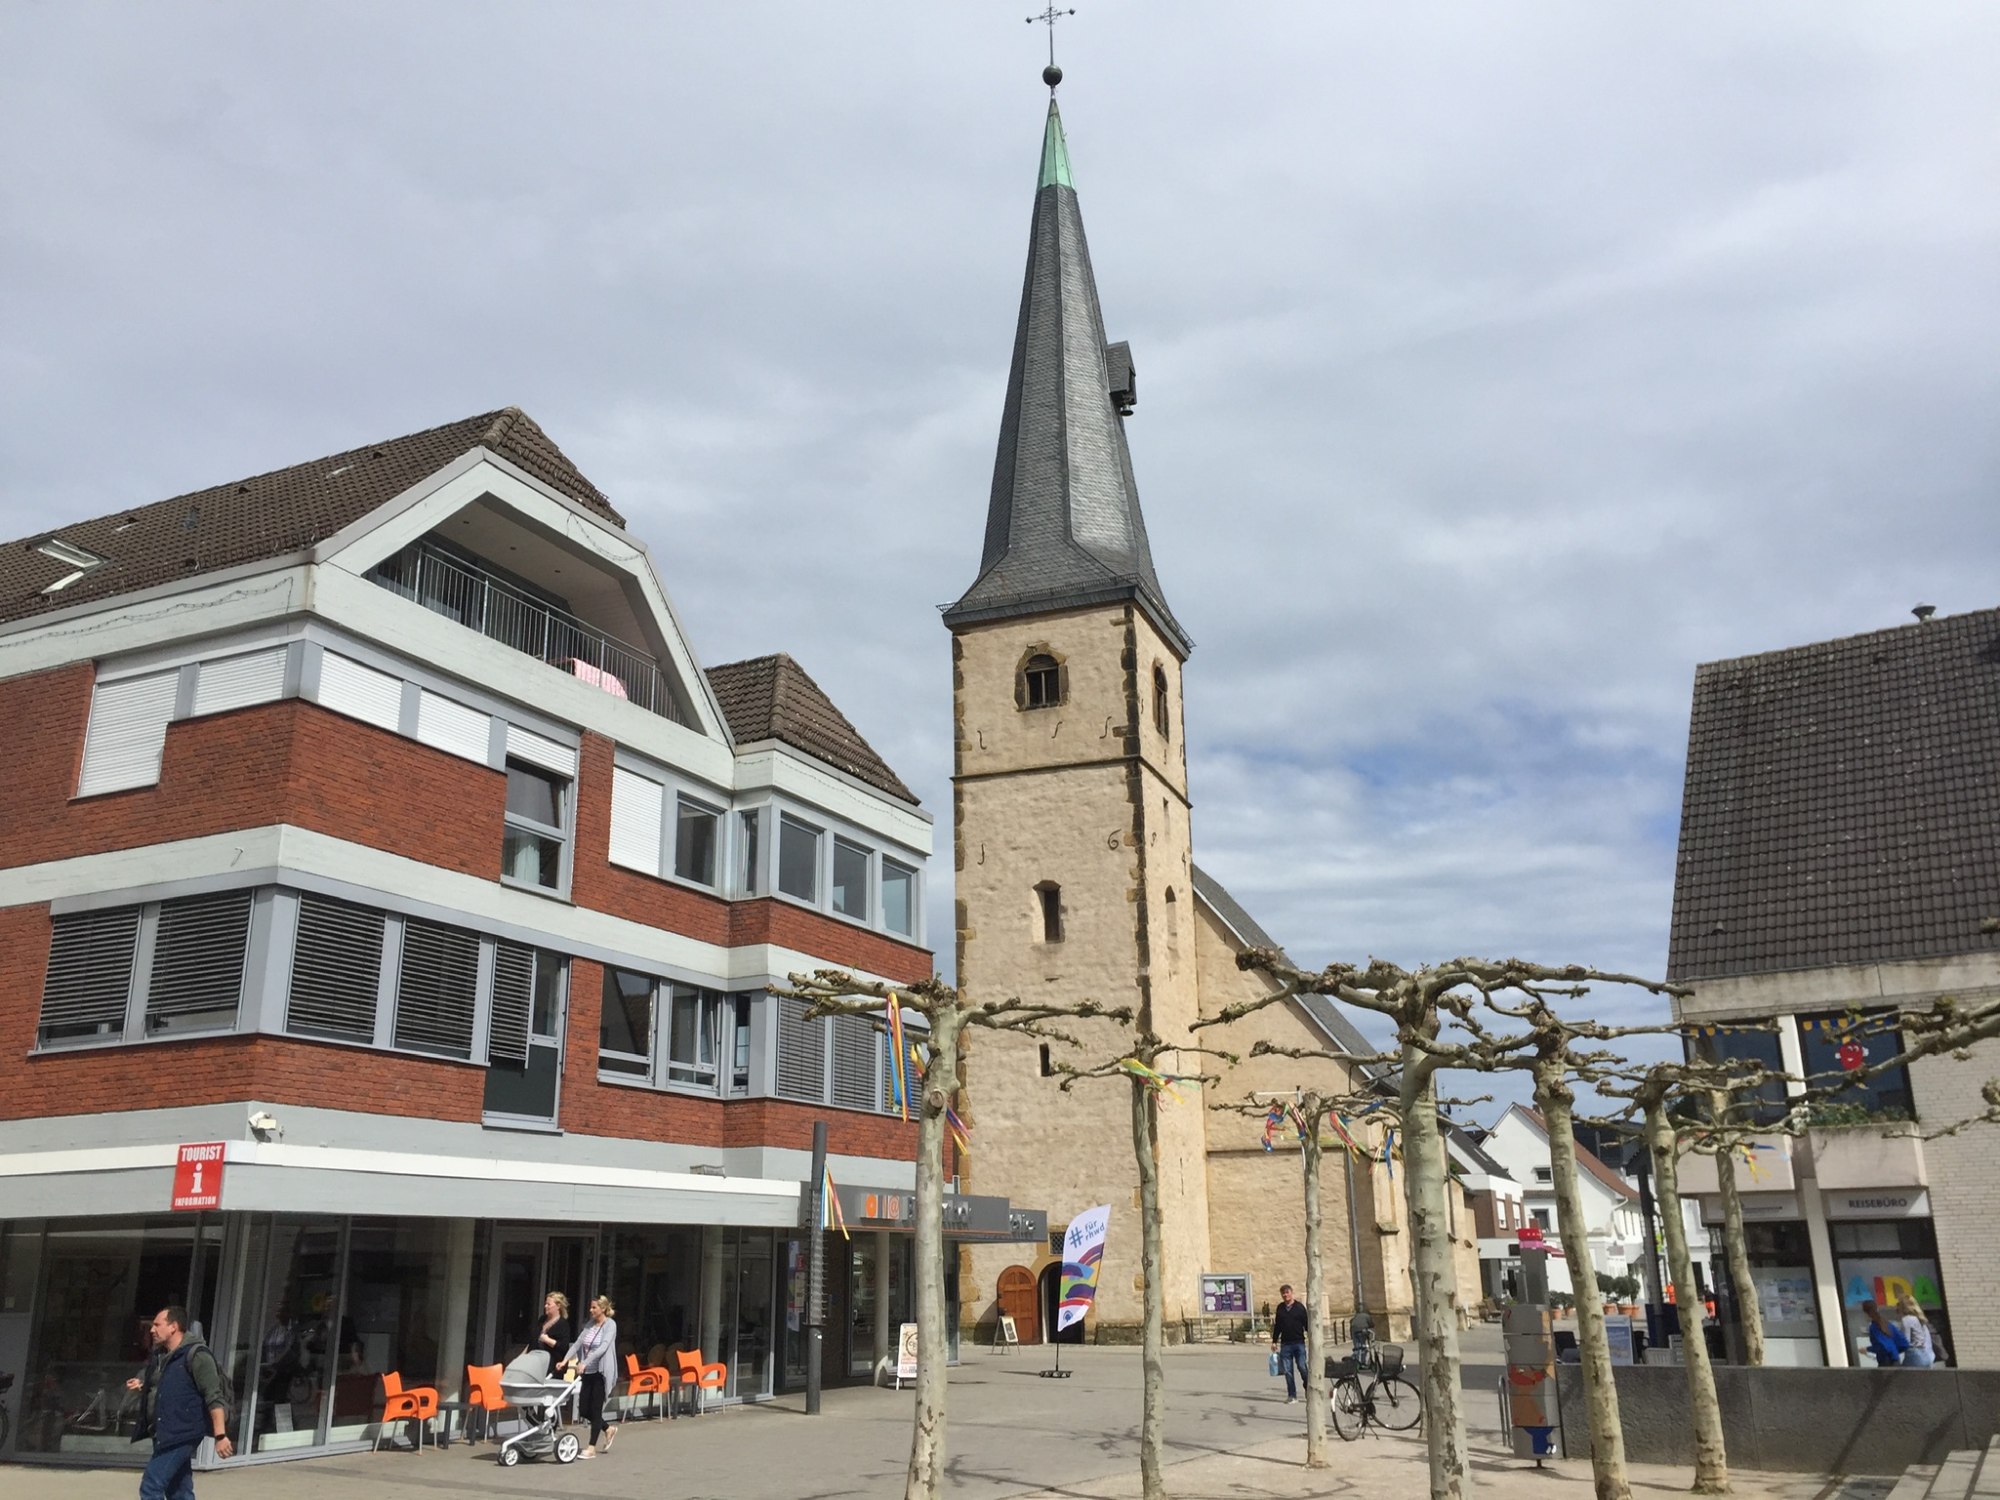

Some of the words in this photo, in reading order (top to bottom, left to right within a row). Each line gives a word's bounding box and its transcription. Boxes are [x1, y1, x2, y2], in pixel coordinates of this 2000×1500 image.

[181, 1145, 222, 1162] TOURIST
[174, 1196, 217, 1207] INFORMATION
[1848, 1196, 1908, 1208] REISEBÜRO
[1844, 1275, 1942, 1309] AIDA
